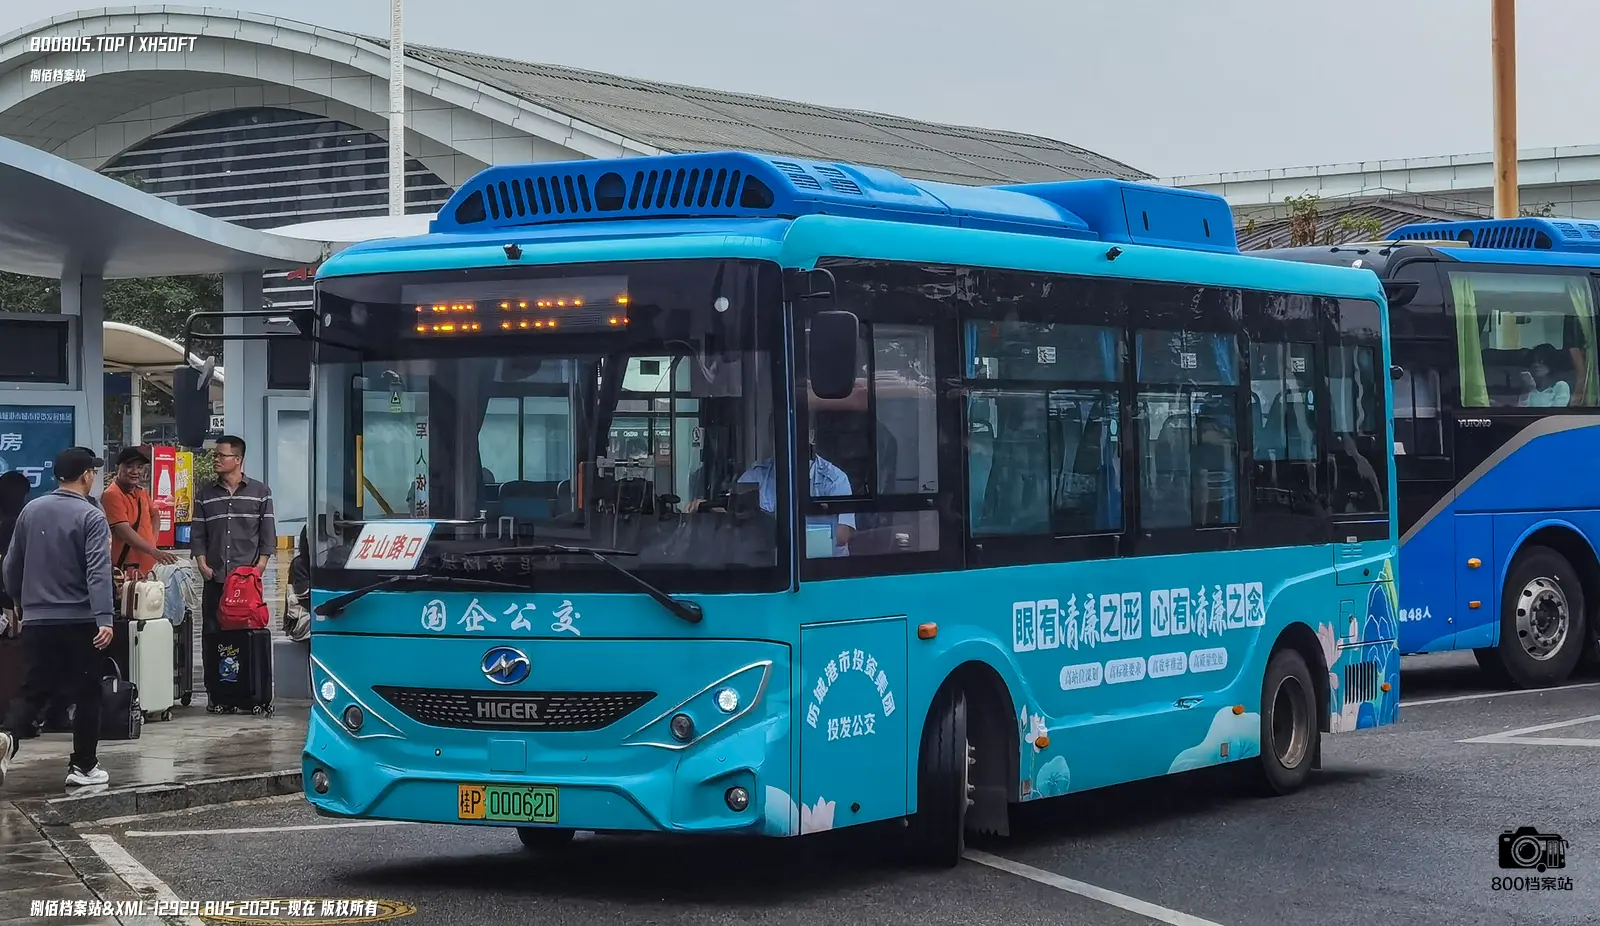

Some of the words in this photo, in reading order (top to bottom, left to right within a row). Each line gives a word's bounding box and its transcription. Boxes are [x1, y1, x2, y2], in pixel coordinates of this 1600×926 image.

[1458, 419, 1491, 428] YUTONG
[0, 433, 23, 451] 房
[354, 533, 423, 560] 龙山路口
[420, 598, 581, 637] 国企公交
[1014, 593, 1142, 651] 眼有清廉之形
[1151, 583, 1265, 638] 心有清廉之念
[477, 701, 539, 720] HIGER
[827, 712, 876, 741] 投发公交
